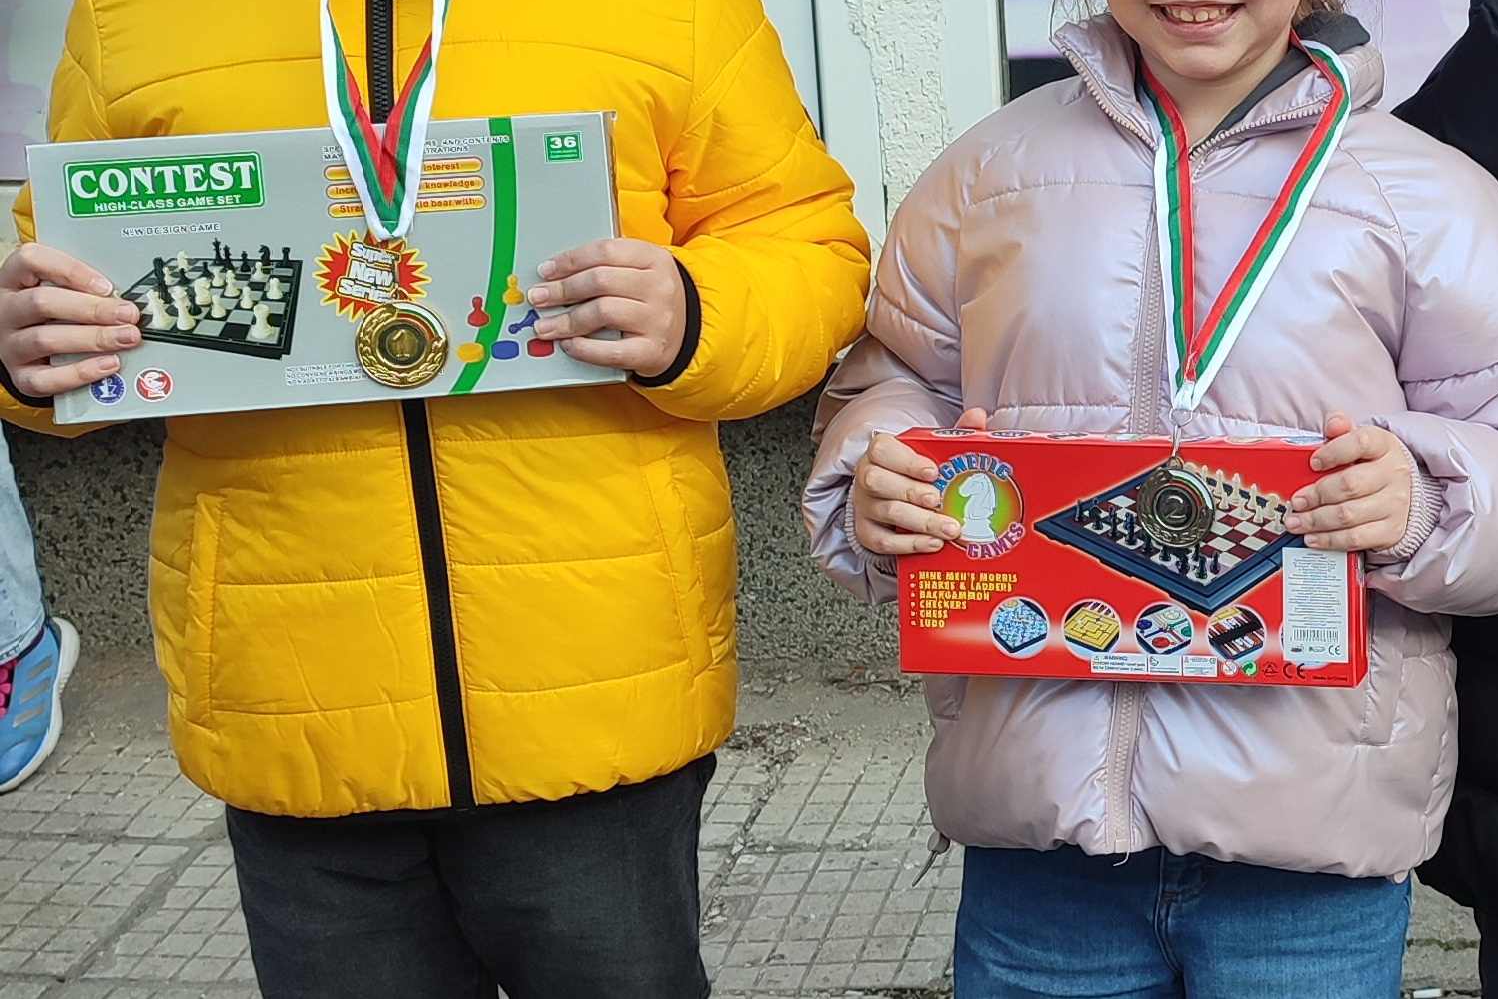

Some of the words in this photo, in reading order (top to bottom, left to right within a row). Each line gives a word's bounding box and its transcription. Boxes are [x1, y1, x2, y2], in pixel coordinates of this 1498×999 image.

[550, 136, 577, 149] 36
[423, 145, 469, 154] TRATIONS
[70, 160, 256, 199] CONTEST
[424, 180, 475, 189] knowledge
[335, 186, 358, 195] Incr
[94, 197, 175, 213] HIGH-CLASS
[176, 195, 215, 208] GAME
[216, 194, 242, 205] SET
[122, 227, 144, 237] NEW
[189, 223, 221, 233] GAME
[349, 260, 394, 287] New
[931, 452, 1012, 492] AGNETIC
[1165, 495, 1187, 521] 2
[966, 522, 1025, 559] GAMES
[918, 570, 942, 581] NINE
[979, 572, 1018, 583] MORRIS
[969, 580, 1013, 592] LADDERS
[919, 589, 990, 601] BACKGAMMON
[919, 600, 967, 610] CHECKERS
[919, 609, 949, 619] CHESS
[919, 618, 946, 629] LUDO
